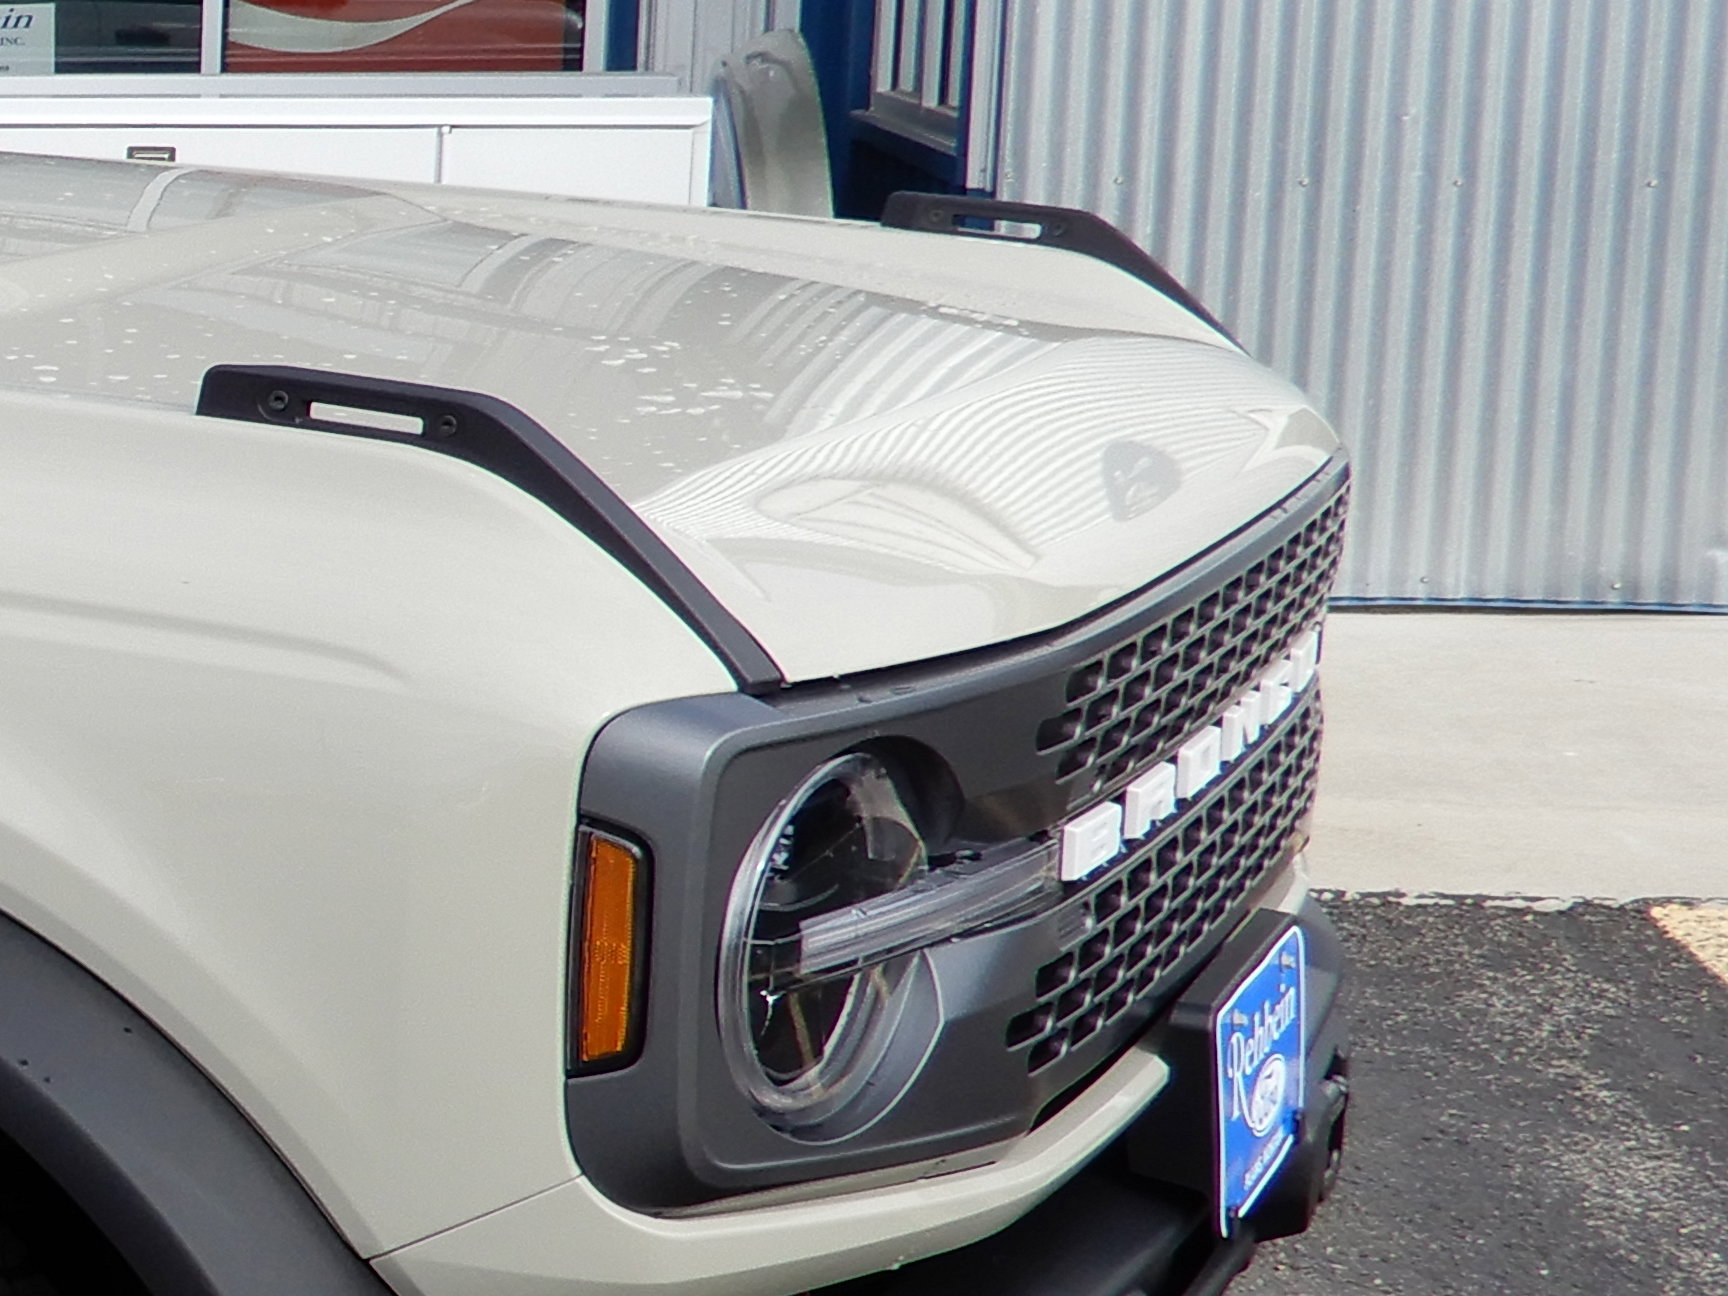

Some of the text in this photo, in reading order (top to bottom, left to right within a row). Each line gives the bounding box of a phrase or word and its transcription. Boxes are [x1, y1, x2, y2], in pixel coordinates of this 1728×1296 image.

[0, 37, 26, 46] INC.
[1060, 631, 1319, 882] BRONCO
[1227, 983, 1297, 1124] Rehbein
